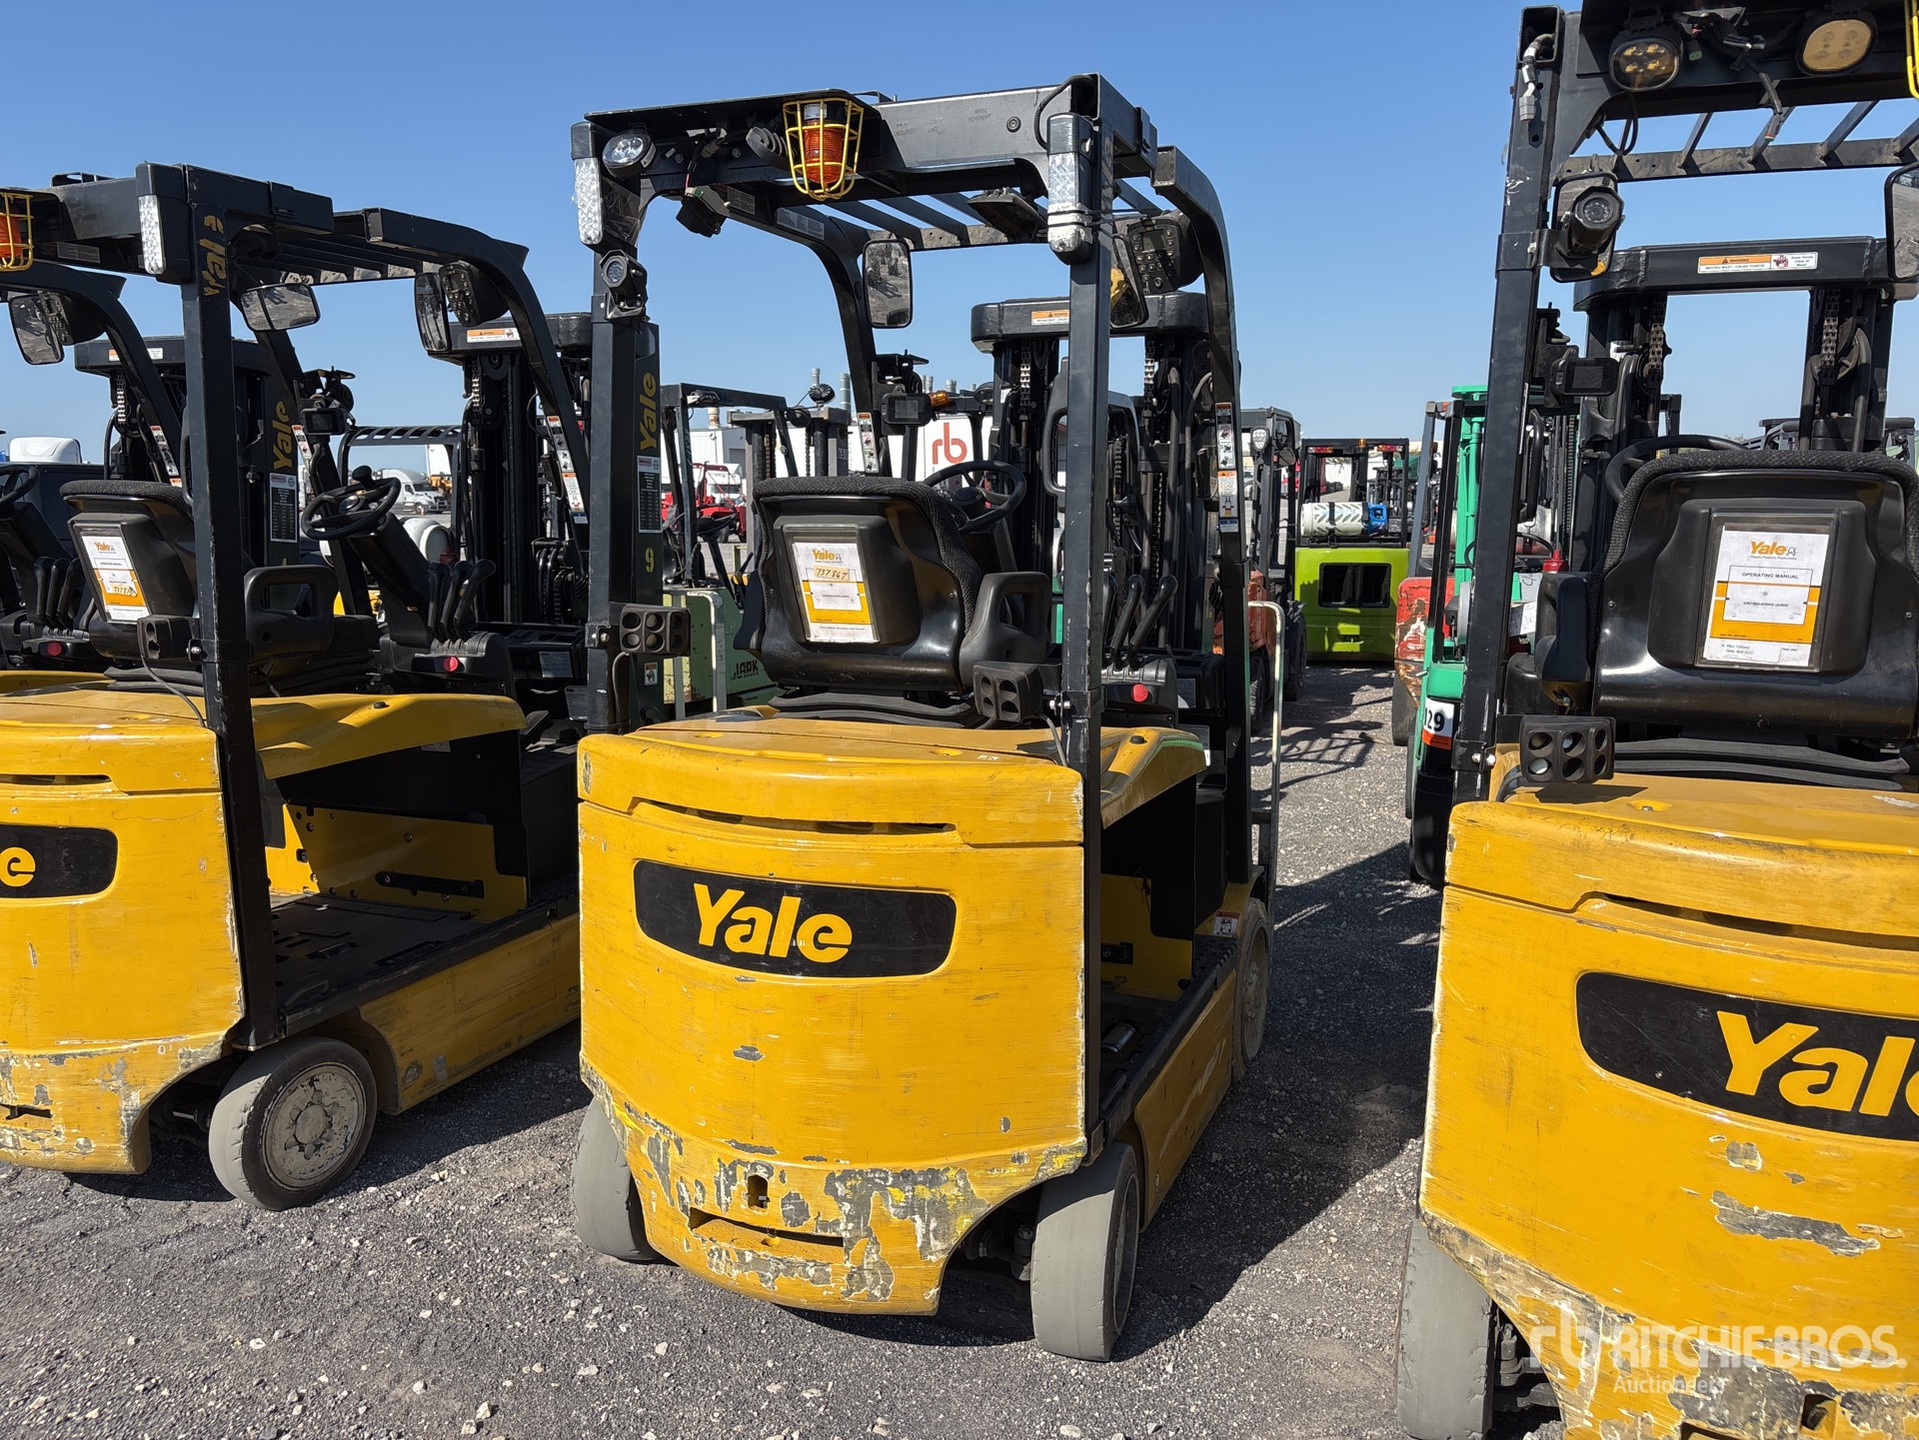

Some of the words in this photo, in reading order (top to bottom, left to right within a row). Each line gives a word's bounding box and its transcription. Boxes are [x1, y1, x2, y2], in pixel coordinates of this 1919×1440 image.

[640, 372, 657, 450] Yale
[272, 401, 292, 470] Yale
[95, 542, 110, 551] Yale
[645, 547, 656, 573] 9
[812, 549, 835, 561] Yale
[1750, 541, 1787, 556] Yale
[694, 883, 852, 963] Yale
[1716, 1010, 1919, 1117] Yal
